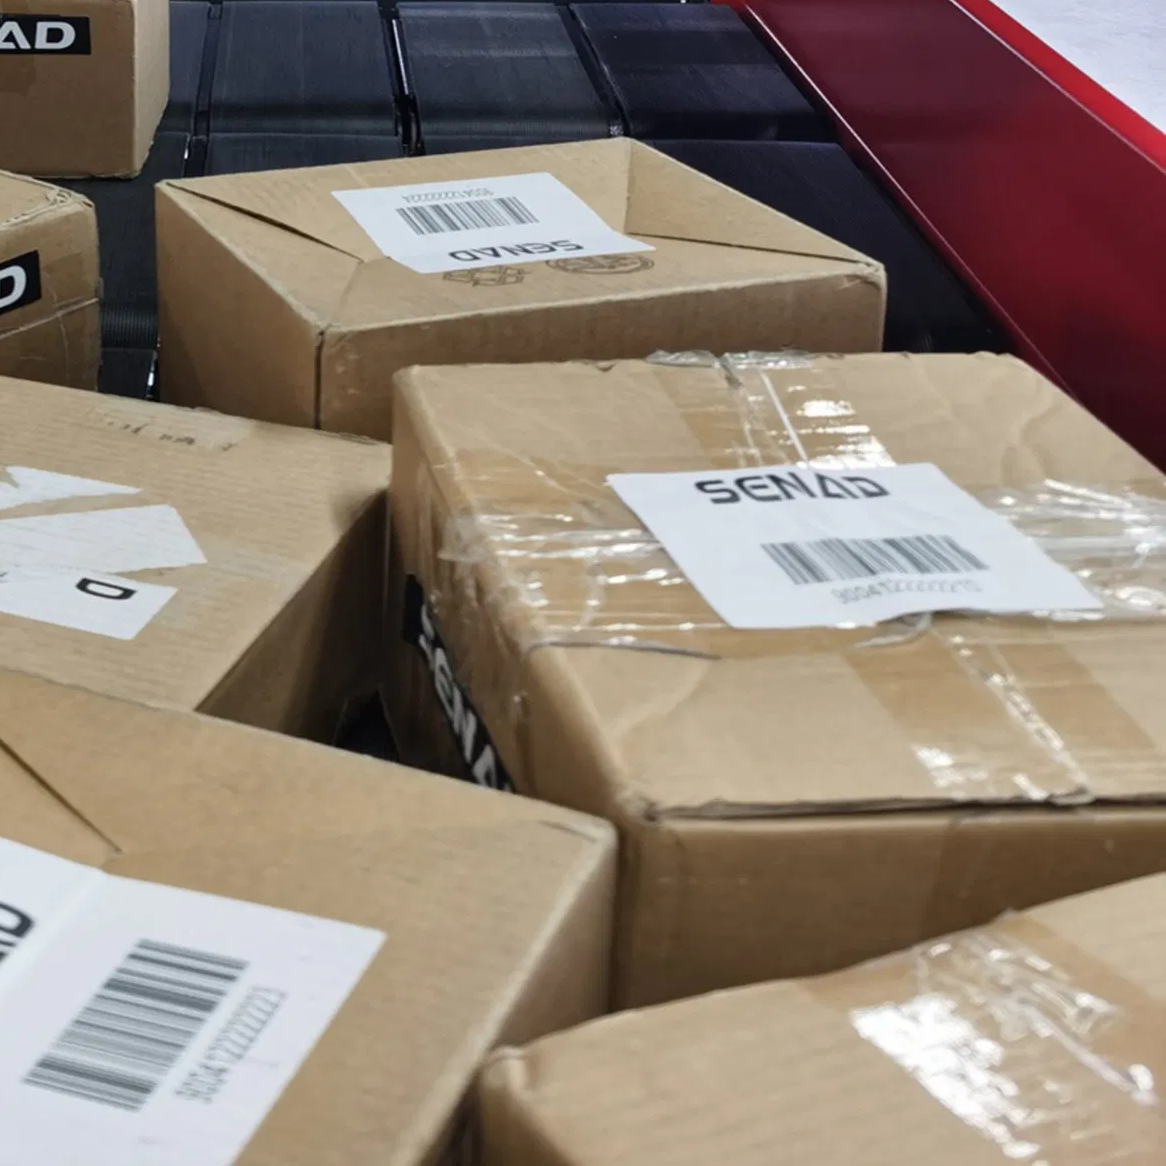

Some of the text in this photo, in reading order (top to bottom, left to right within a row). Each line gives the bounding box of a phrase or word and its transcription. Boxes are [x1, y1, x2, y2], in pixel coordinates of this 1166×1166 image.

[448, 239, 585, 263] SENAD
[694, 471, 892, 504] SENAD
[418, 603, 512, 792] SENA
